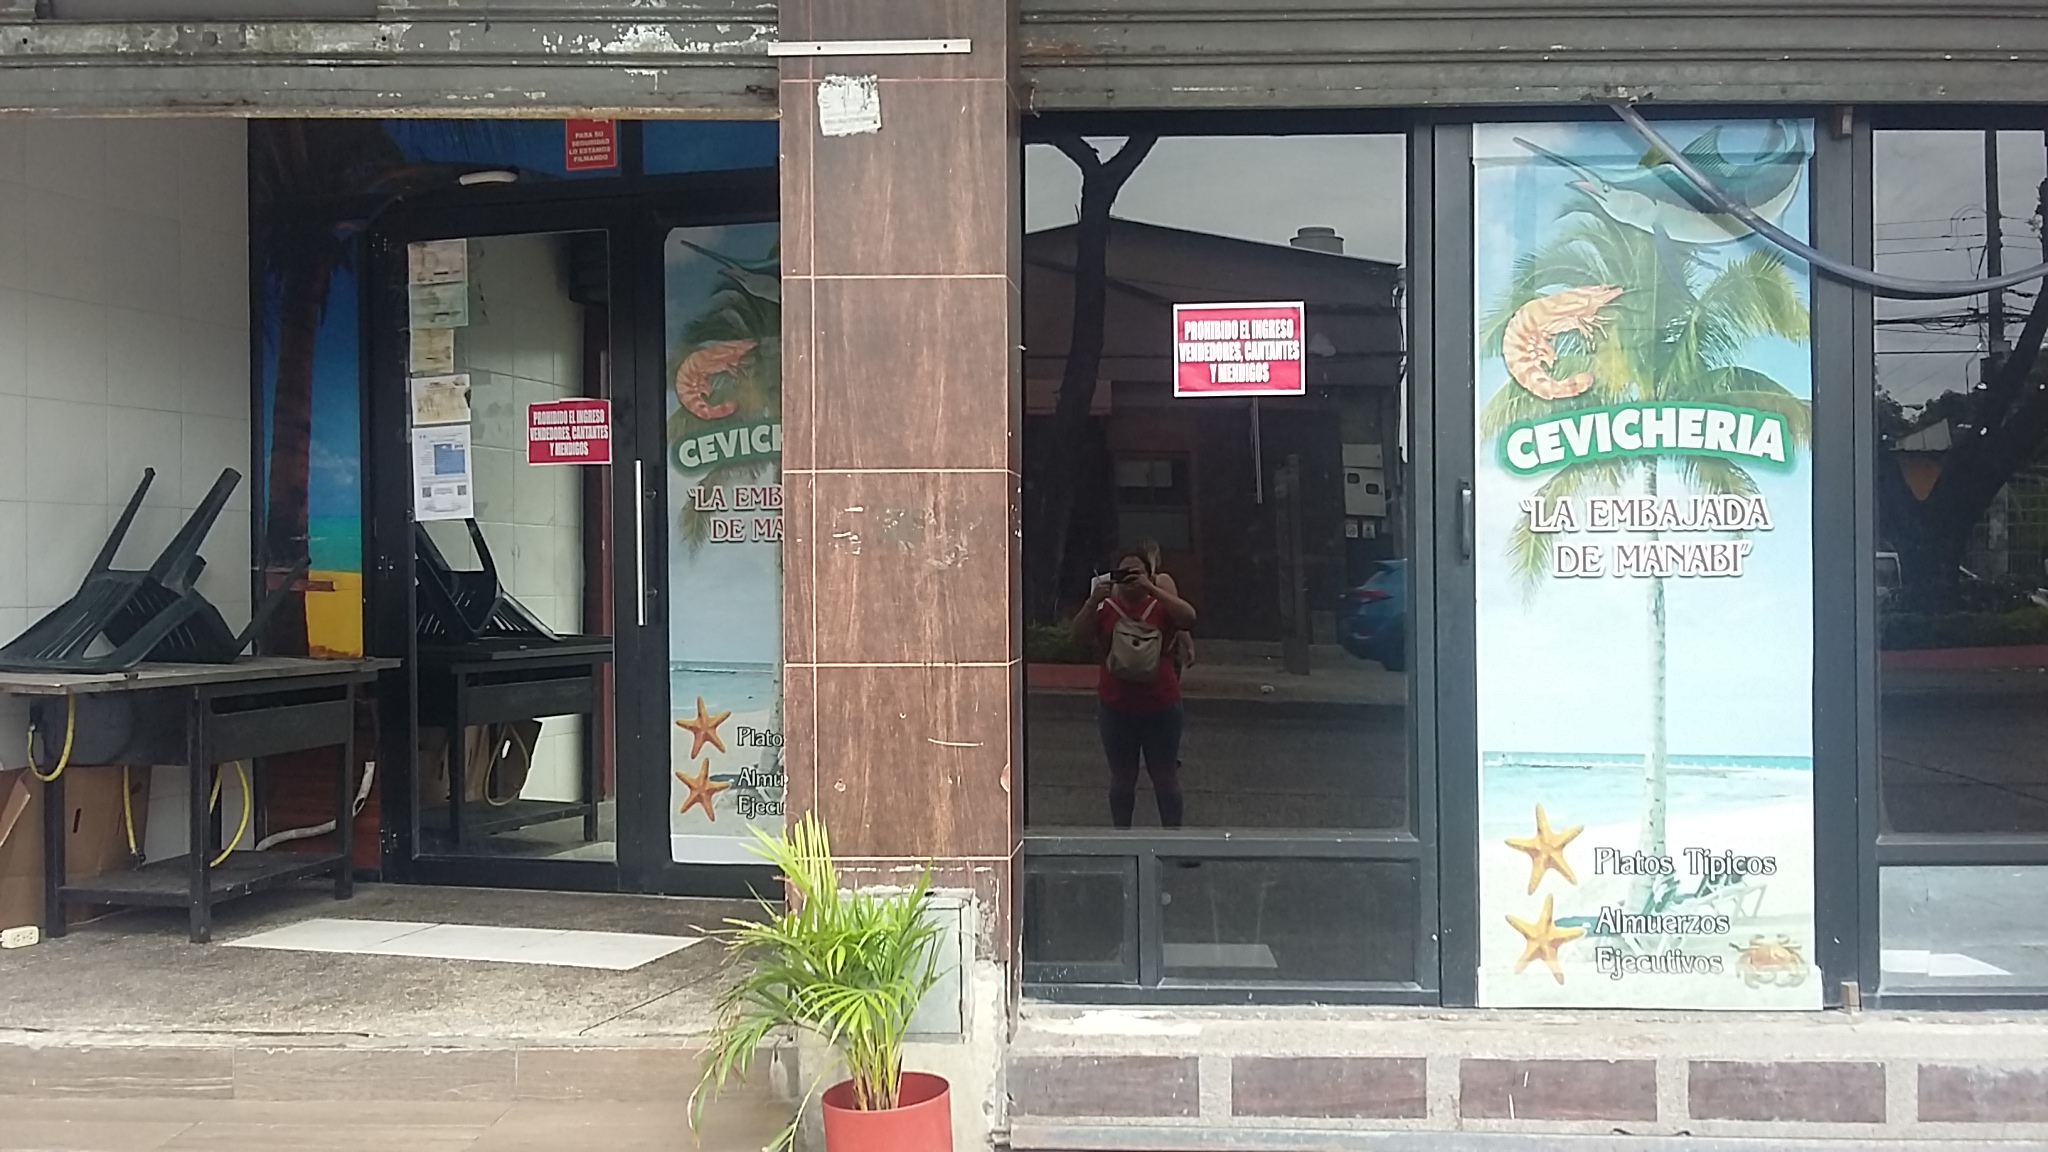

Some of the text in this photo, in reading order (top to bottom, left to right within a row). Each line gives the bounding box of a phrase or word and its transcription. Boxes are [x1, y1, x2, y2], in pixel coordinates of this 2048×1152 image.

[571, 138, 610, 147] SEGURIDAD
[579, 146, 611, 154] ESTAMOS
[573, 154, 609, 162] FILMANDO
[1184, 319, 1294, 341] PROHIBIDO EL INGRESO
[1179, 340, 1300, 362] VENDEDORES, CANTANTES
[1209, 362, 1270, 383] Y MENDIGOS
[533, 409, 605, 425] PROHIBIDO EL INGRESO
[530, 424, 609, 441] VENDEDORES, CANTANTES
[1506, 407, 1786, 469] CEVICHERIA
[549, 441, 589, 457] Y MENDIGOS
[1588, 496, 1774, 532] EMBAJADA
[710, 517, 746, 541] DE
[1554, 543, 1603, 577] DE
[1595, 847, 1777, 881] Platos Típicos
[1595, 906, 1730, 934] Almuerzos
[1595, 947, 1724, 980] Ejecutivos
